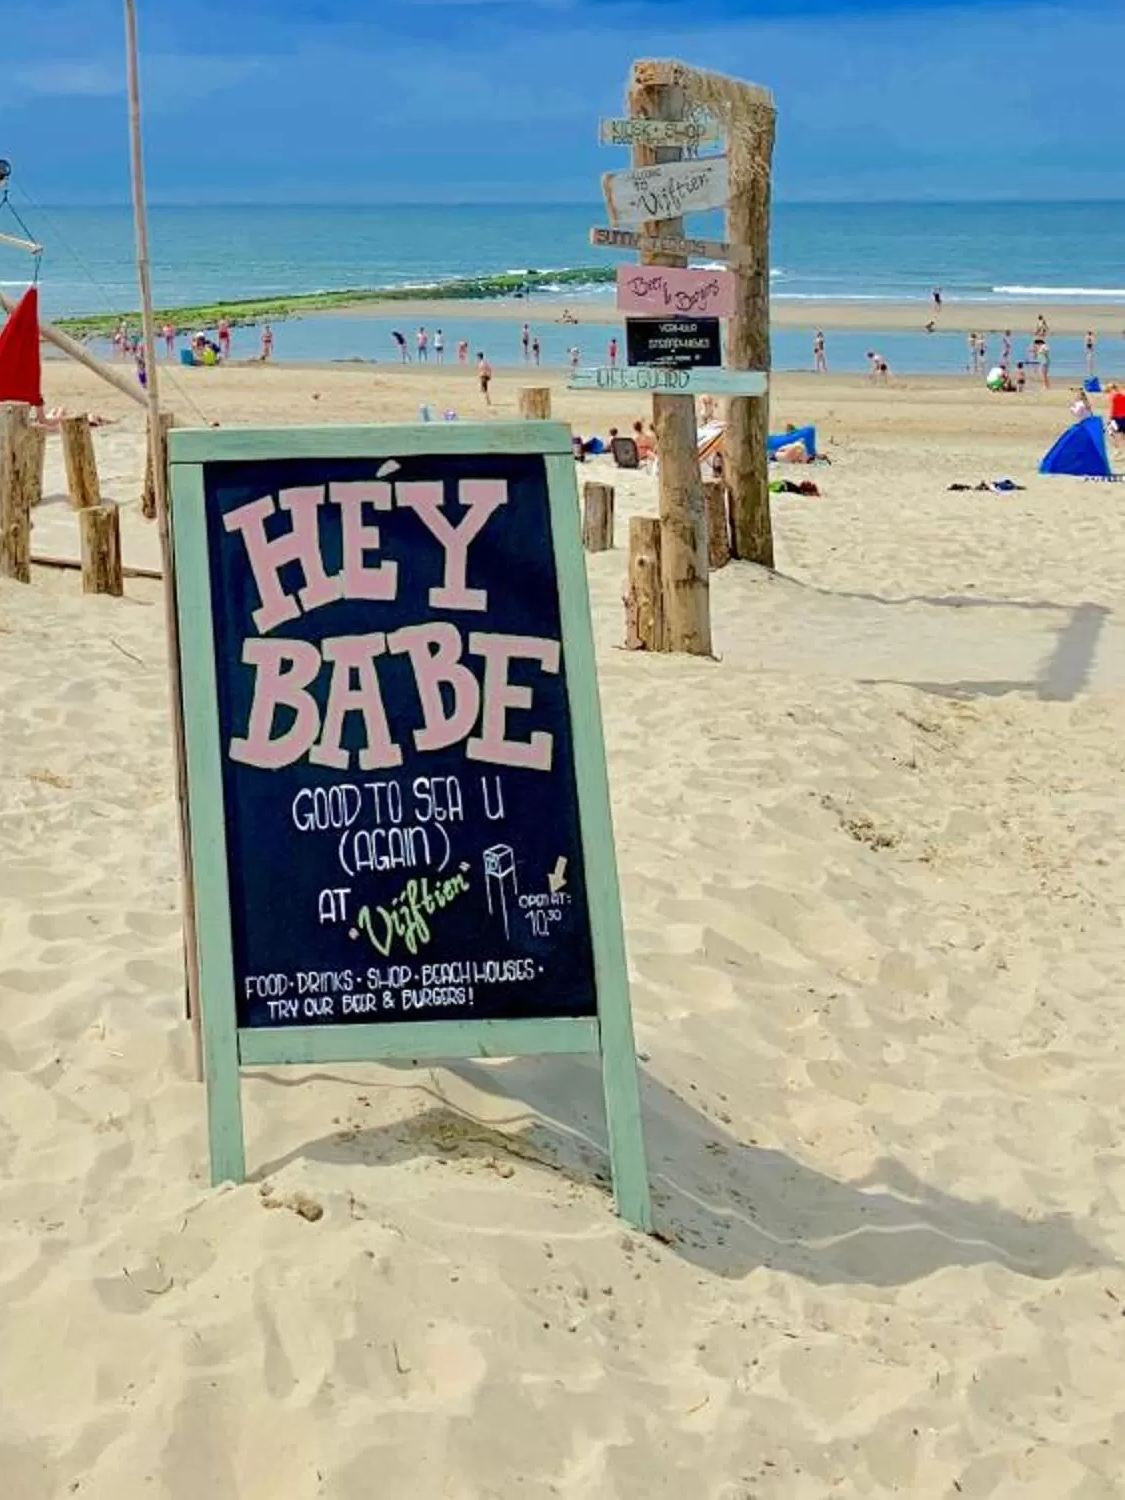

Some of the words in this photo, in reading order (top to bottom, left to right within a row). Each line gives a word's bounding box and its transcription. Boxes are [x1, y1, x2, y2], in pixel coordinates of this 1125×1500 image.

[229, 621, 560, 771] BABE
[292, 784, 362, 831] GOOD
[364, 780, 403, 824] TO
[481, 776, 505, 819] U
[339, 822, 450, 876] (AGAIN)
[319, 888, 351, 924] AT
[422, 961, 471, 986] BEACH
[267, 1000, 298, 1020] TRY
[304, 996, 333, 1017] OUR
[343, 992, 377, 1014] BEER
[382, 990, 395, 1009] &
